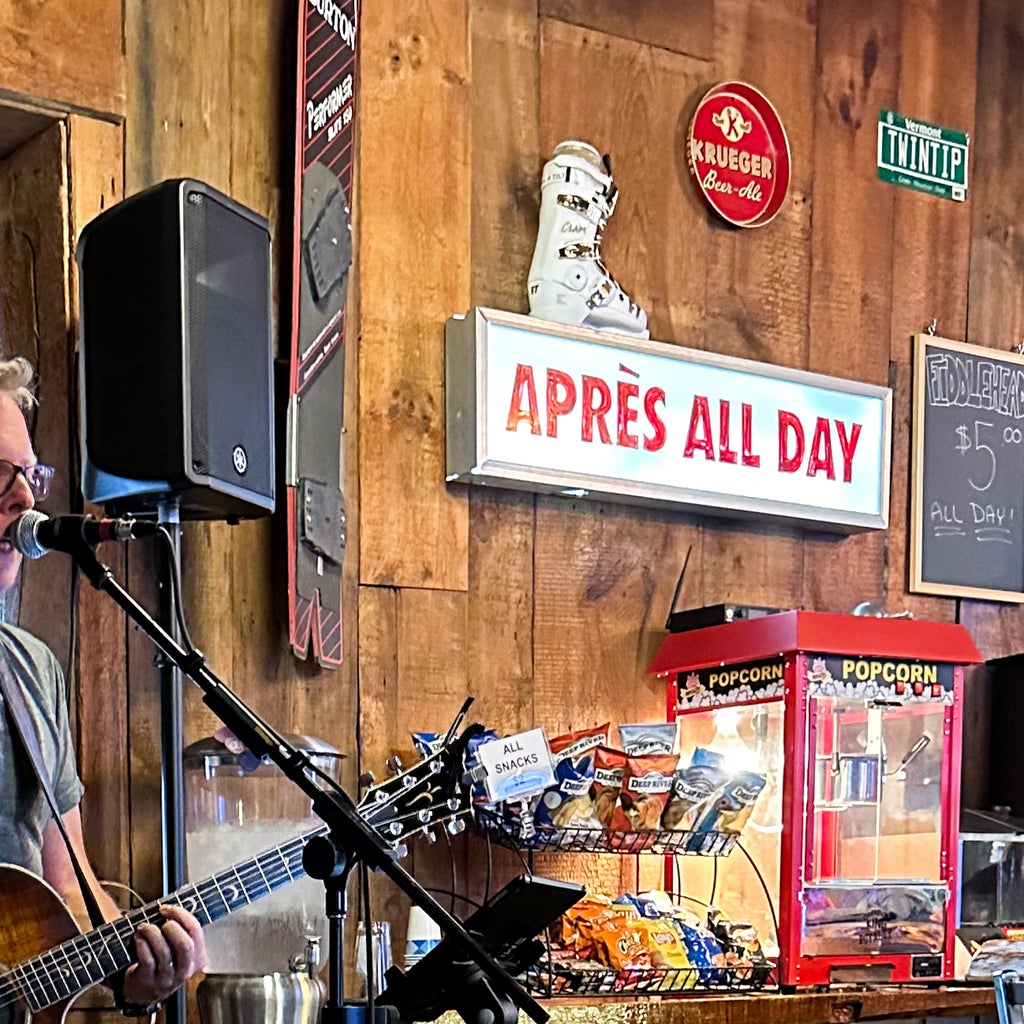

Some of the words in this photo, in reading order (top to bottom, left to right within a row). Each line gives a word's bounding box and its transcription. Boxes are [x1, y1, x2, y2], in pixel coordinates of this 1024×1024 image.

[905, 118, 942, 138] Vermont
[690, 139, 773, 180] KRUEGER
[888, 129, 961, 180] TWINTIP
[703, 169, 762, 202] Beer-Ale
[505, 362, 667, 453] APRÈS
[683, 395, 760, 469] ALL
[777, 409, 863, 484] DAY
[931, 502, 964, 524] ALL
[709, 663, 783, 688] POPCORN
[842, 660, 938, 683] POPCORN
[503, 740, 523, 755] ALL
[495, 753, 539, 774] SNACKS
[631, 779, 651, 789] DEEP
